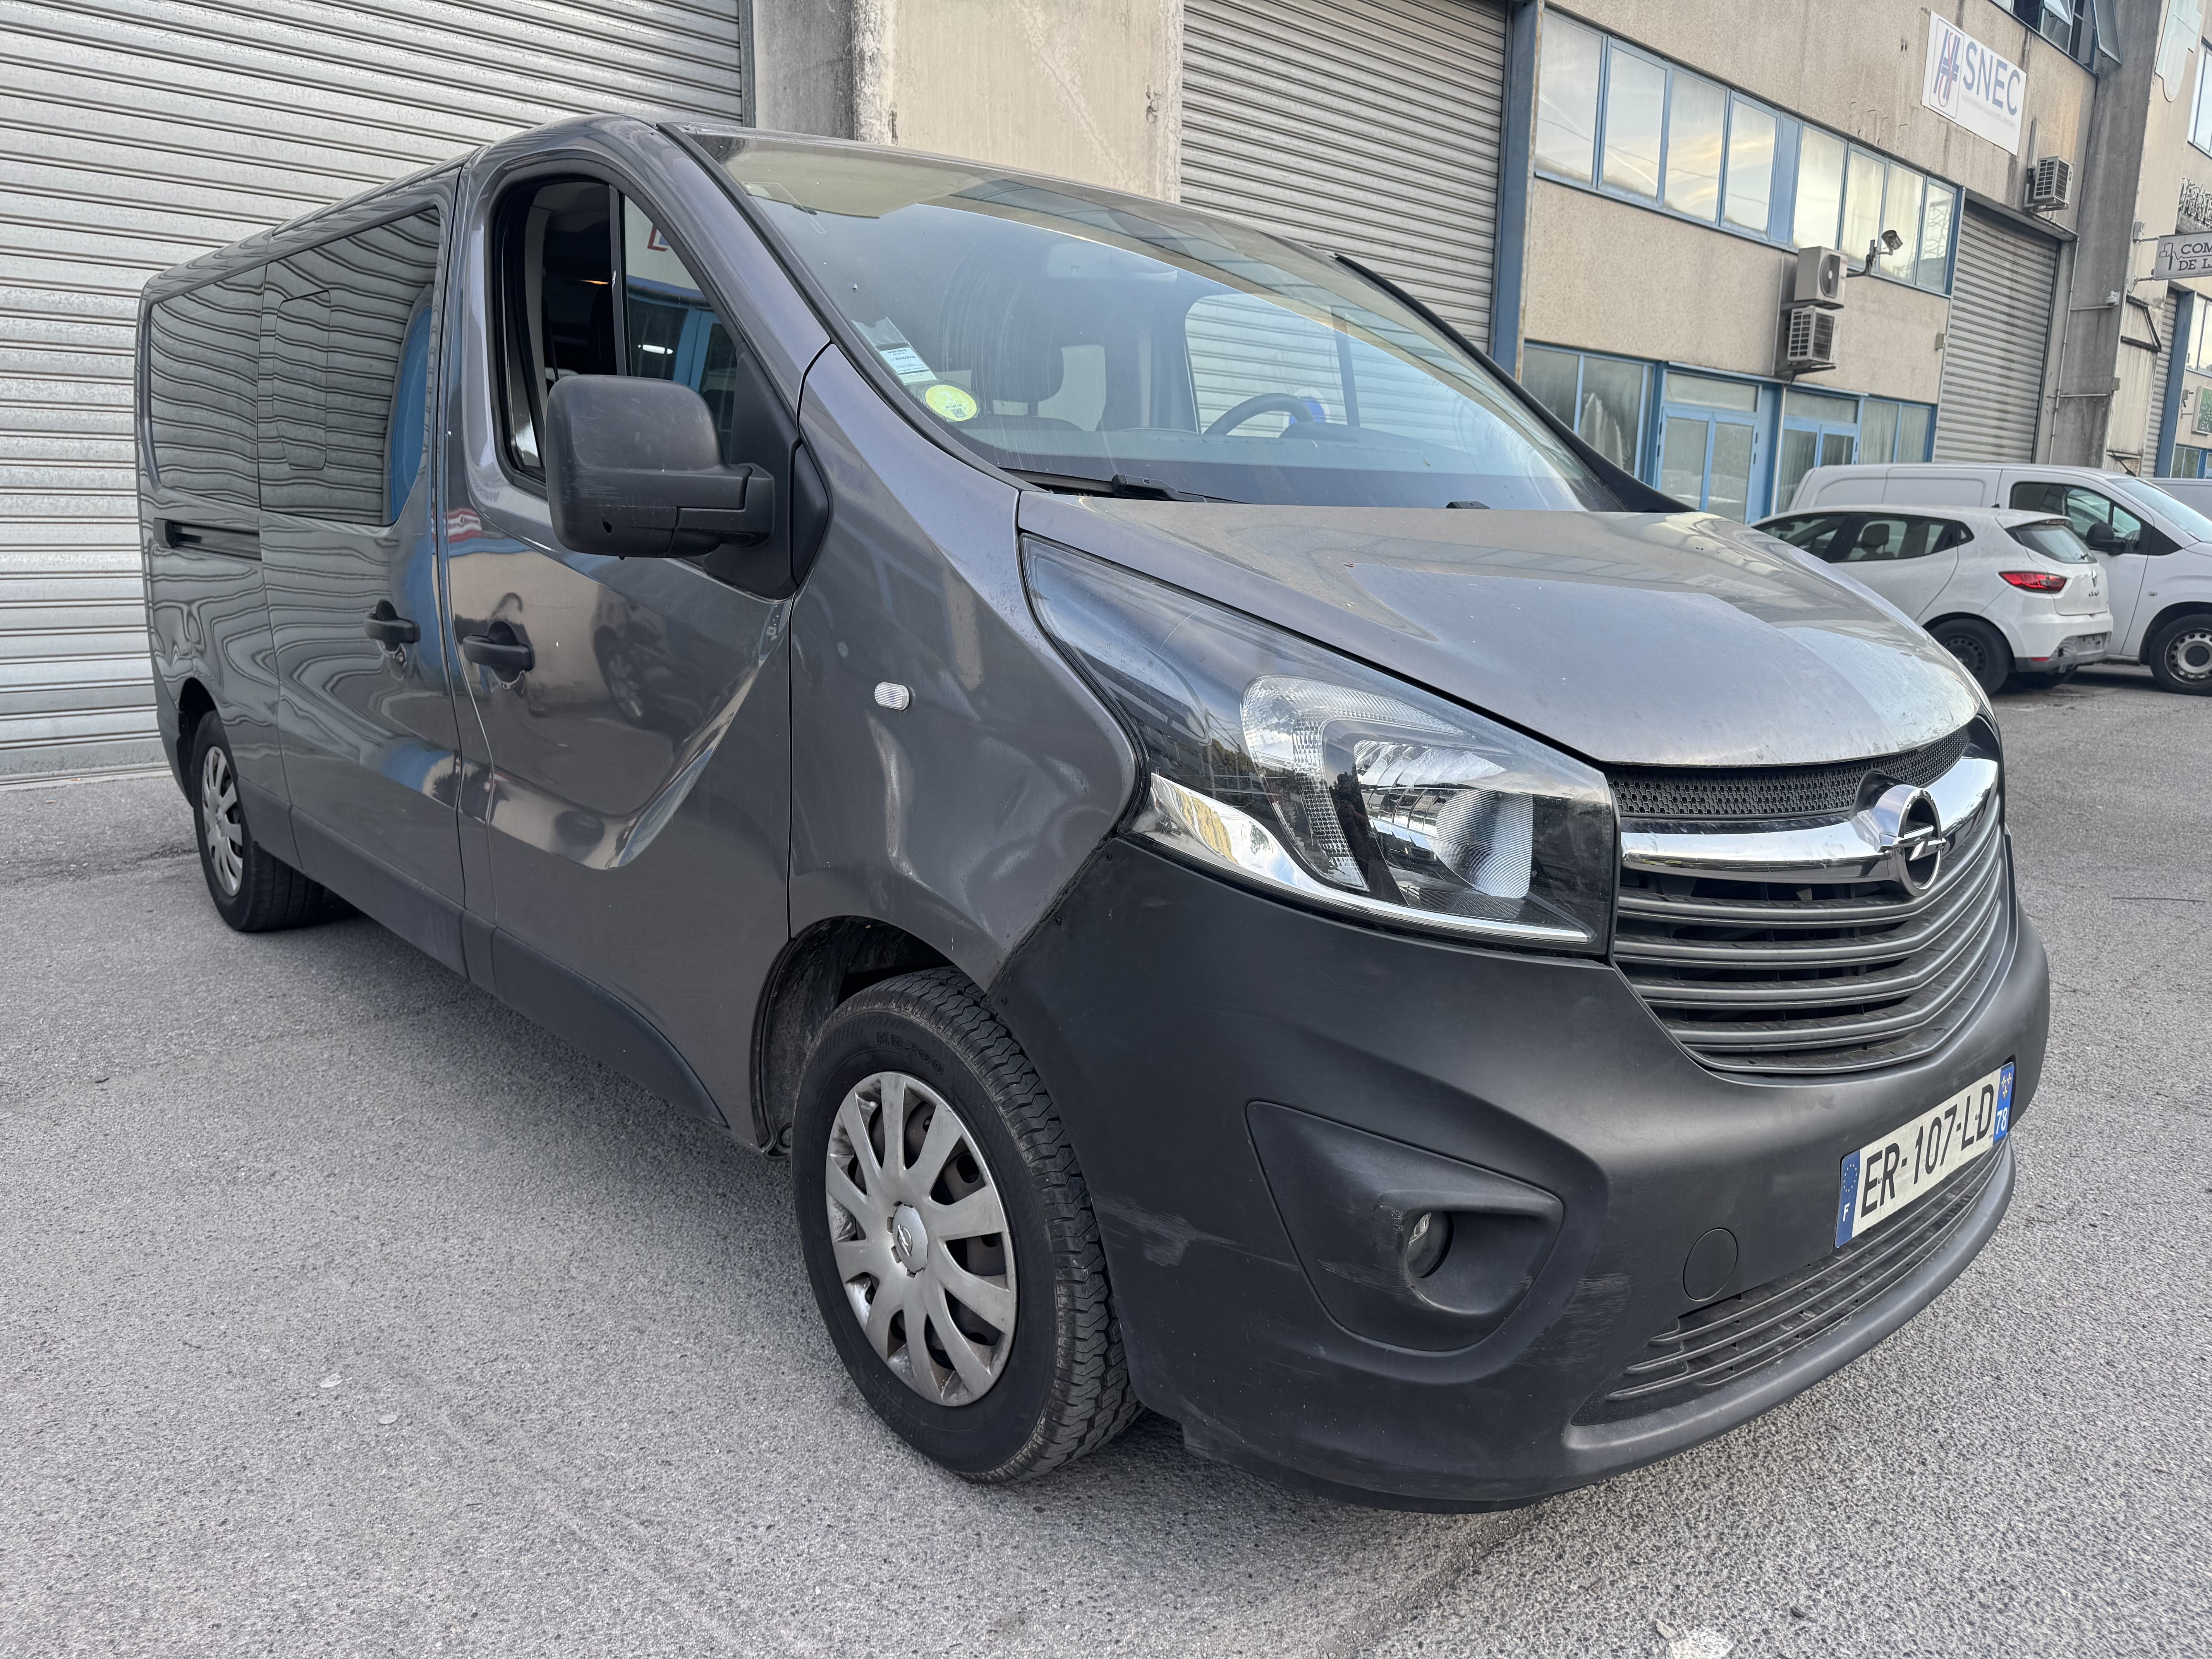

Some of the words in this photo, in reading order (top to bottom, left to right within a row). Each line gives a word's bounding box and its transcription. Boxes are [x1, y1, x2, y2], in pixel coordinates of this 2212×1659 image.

[1963, 41, 2020, 116] SNEC
[2178, 259, 2197, 271] DE
[2201, 258, 2212, 269] L
[1996, 1106, 2008, 1134] 78
[1843, 1202, 1850, 1222] F
[1861, 1084, 1994, 1218] ER-107-LD
